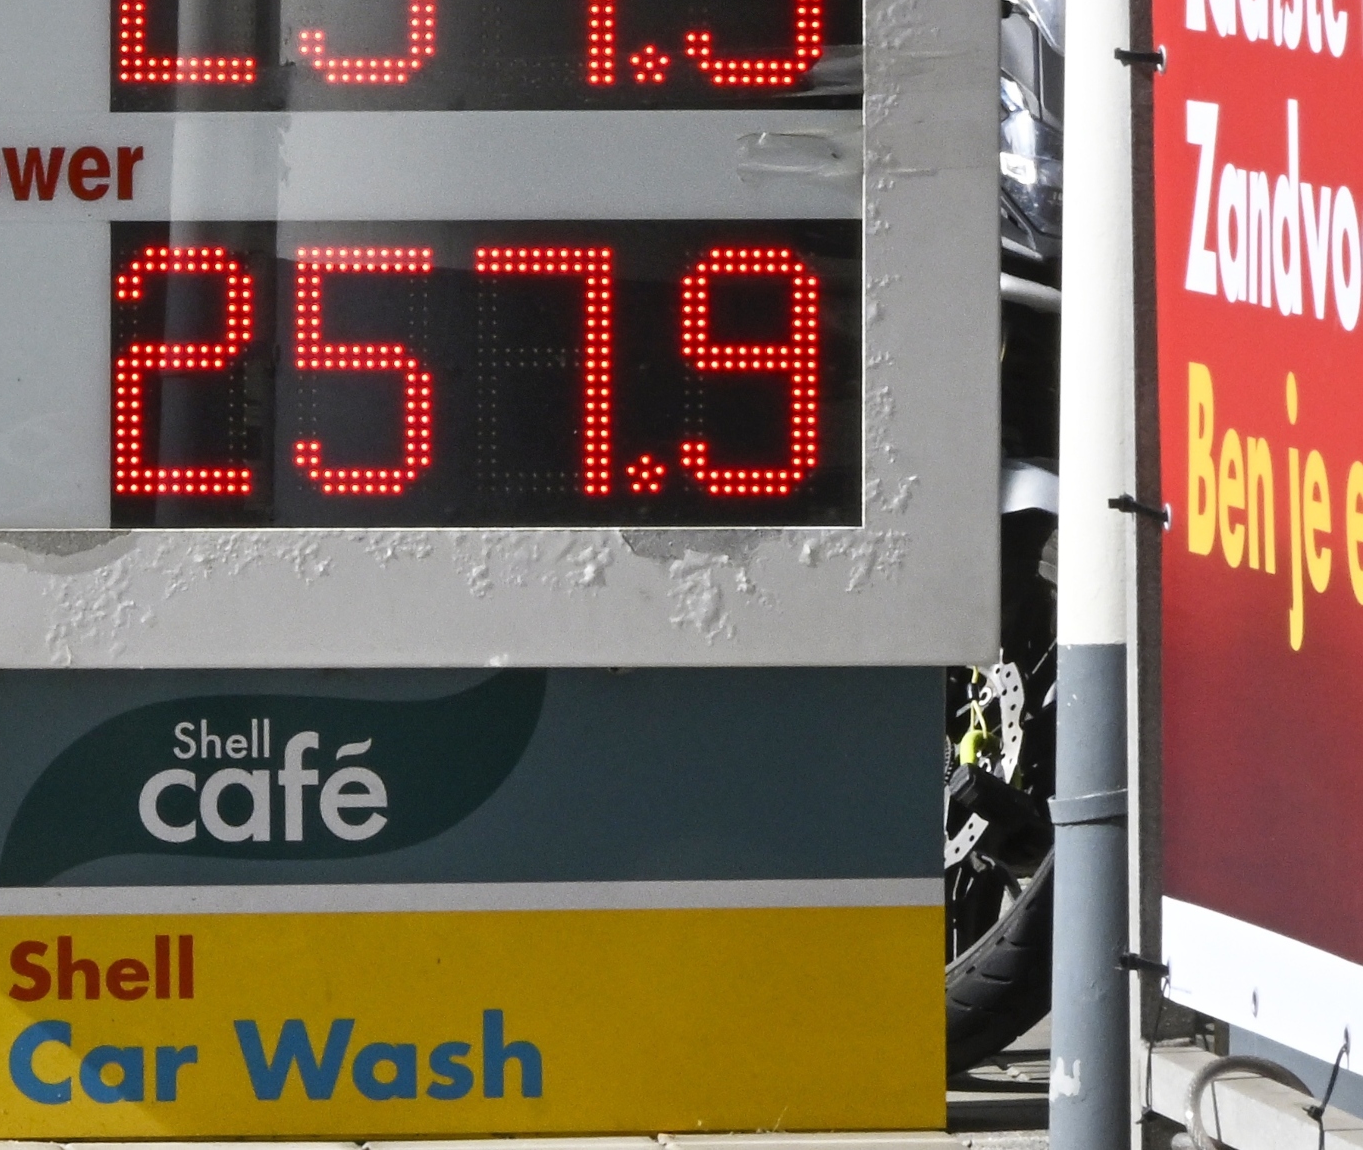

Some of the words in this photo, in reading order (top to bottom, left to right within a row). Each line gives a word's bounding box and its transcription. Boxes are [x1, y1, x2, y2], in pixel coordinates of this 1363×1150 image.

[114, 243, 823, 499] 257.9
[1187, 361, 1277, 575] Ben
[1285, 371, 1333, 652] je
[138, 730, 388, 843] café
[173, 718, 271, 760] Shell
[8, 934, 196, 1001] Shell
[8, 1021, 198, 1105] Car
[235, 1010, 543, 1101] Wash
